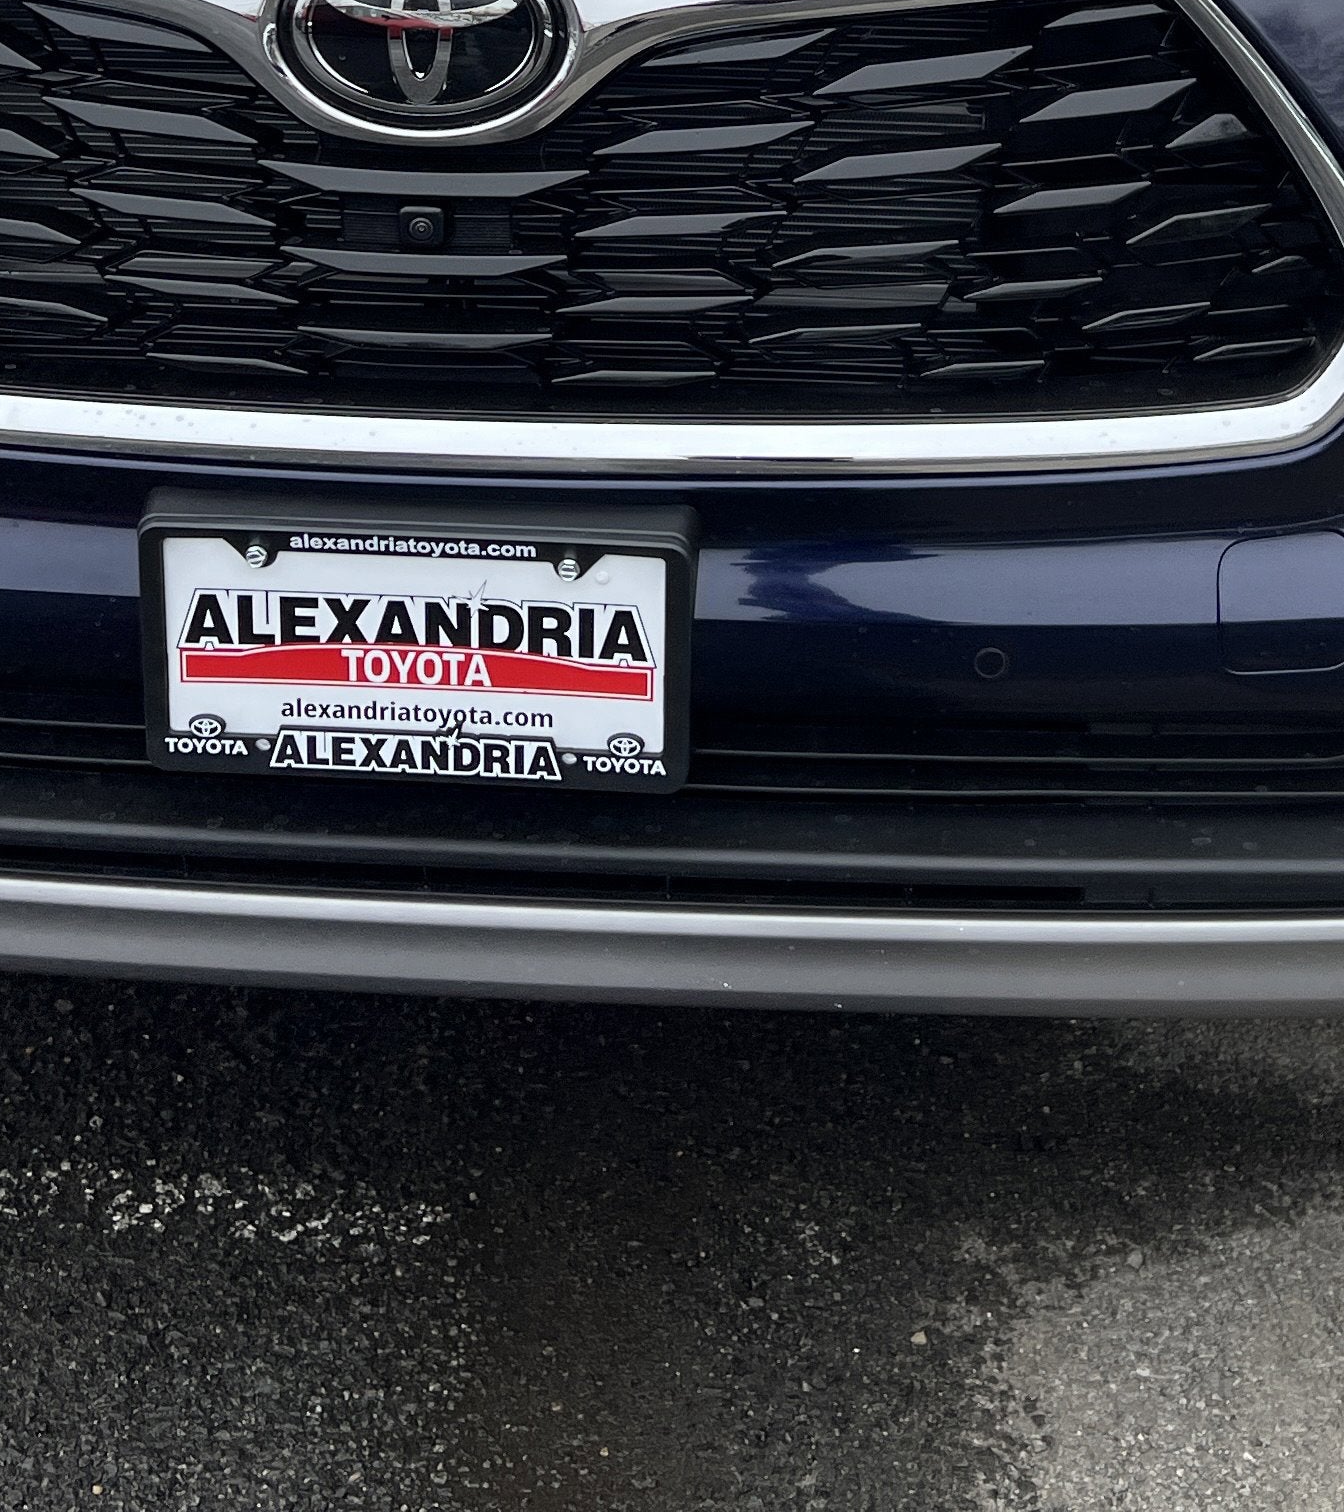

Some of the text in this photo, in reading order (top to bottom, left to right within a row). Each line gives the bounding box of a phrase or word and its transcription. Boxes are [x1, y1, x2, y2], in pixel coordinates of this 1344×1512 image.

[289, 533, 537, 558] alexandriatoyota.com
[182, 591, 651, 663] ALEXANDRIA
[340, 647, 494, 688] TOYOTA
[280, 697, 554, 729] alexandriatoyota.com
[164, 736, 249, 756] TOYOTA
[272, 732, 560, 779] ALEXANDRIA
[582, 755, 667, 776] TOYOTA
